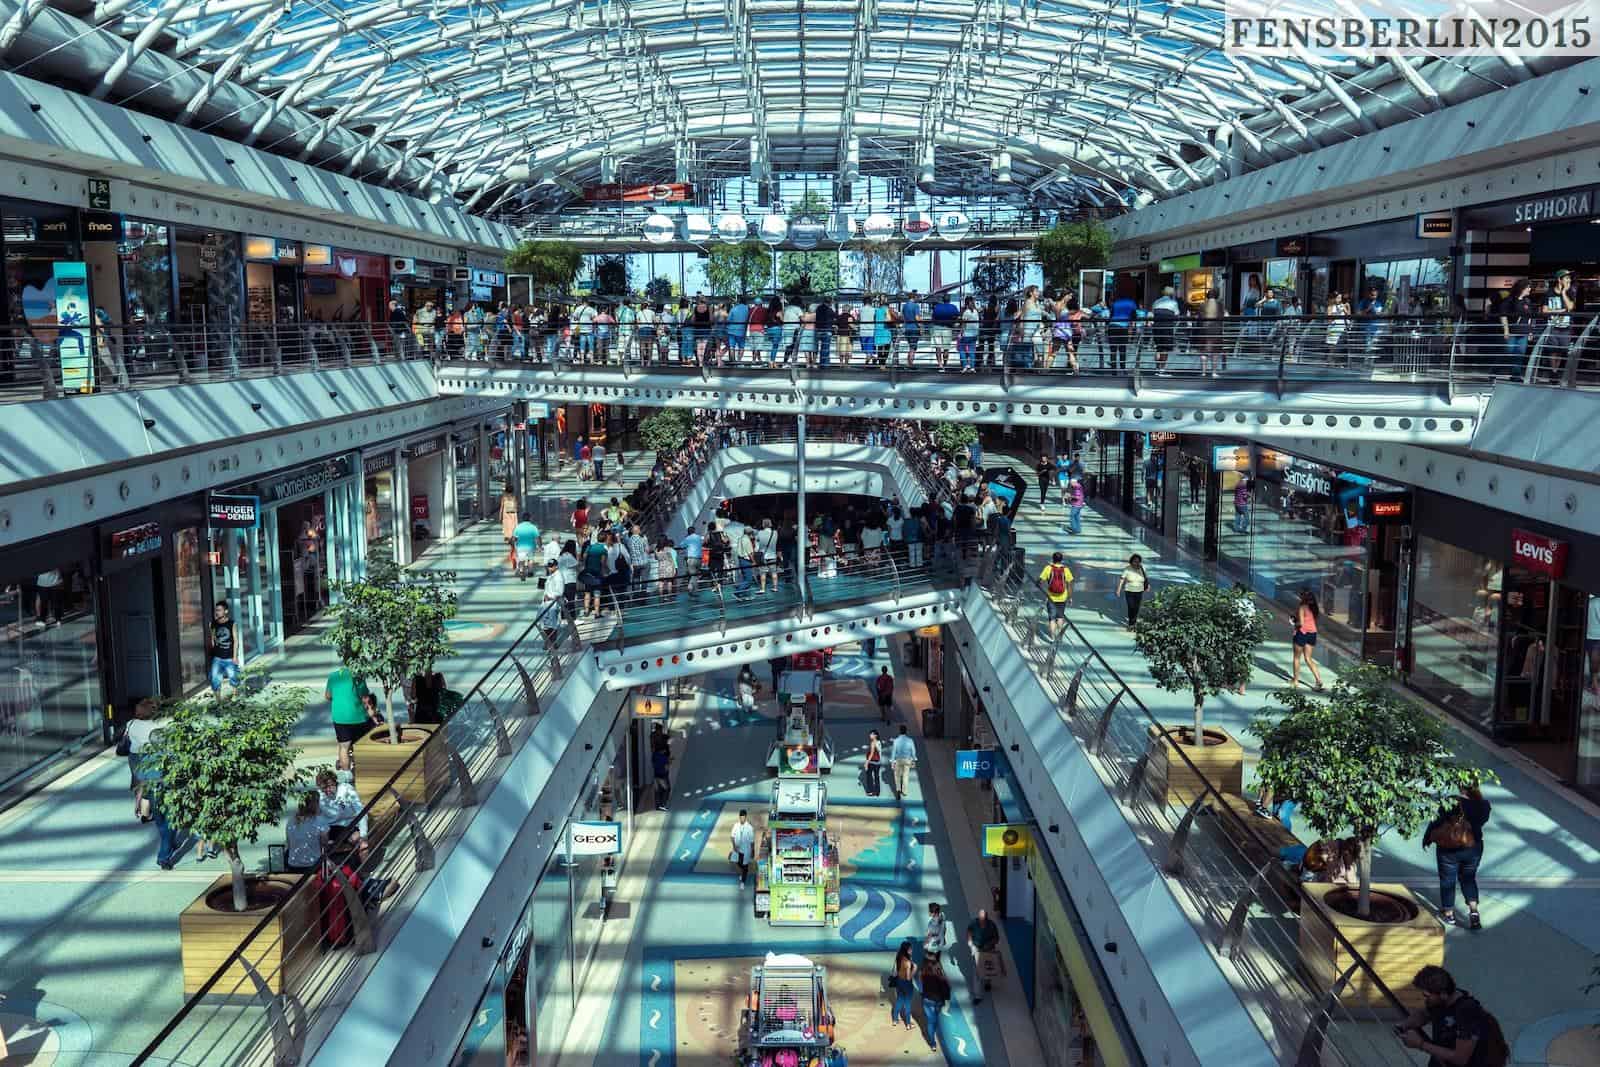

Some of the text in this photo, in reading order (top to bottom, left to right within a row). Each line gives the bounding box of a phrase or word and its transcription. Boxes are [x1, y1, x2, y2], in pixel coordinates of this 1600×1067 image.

[1515, 194, 1589, 222] SEPHORA
[88, 222, 113, 231] fnac
[1283, 465, 1331, 496] Samsonite
[211, 504, 254, 514] HILFIGER
[227, 513, 255, 521] DENIM
[962, 760, 991, 770] MEO
[574, 834, 617, 844] GEOX
